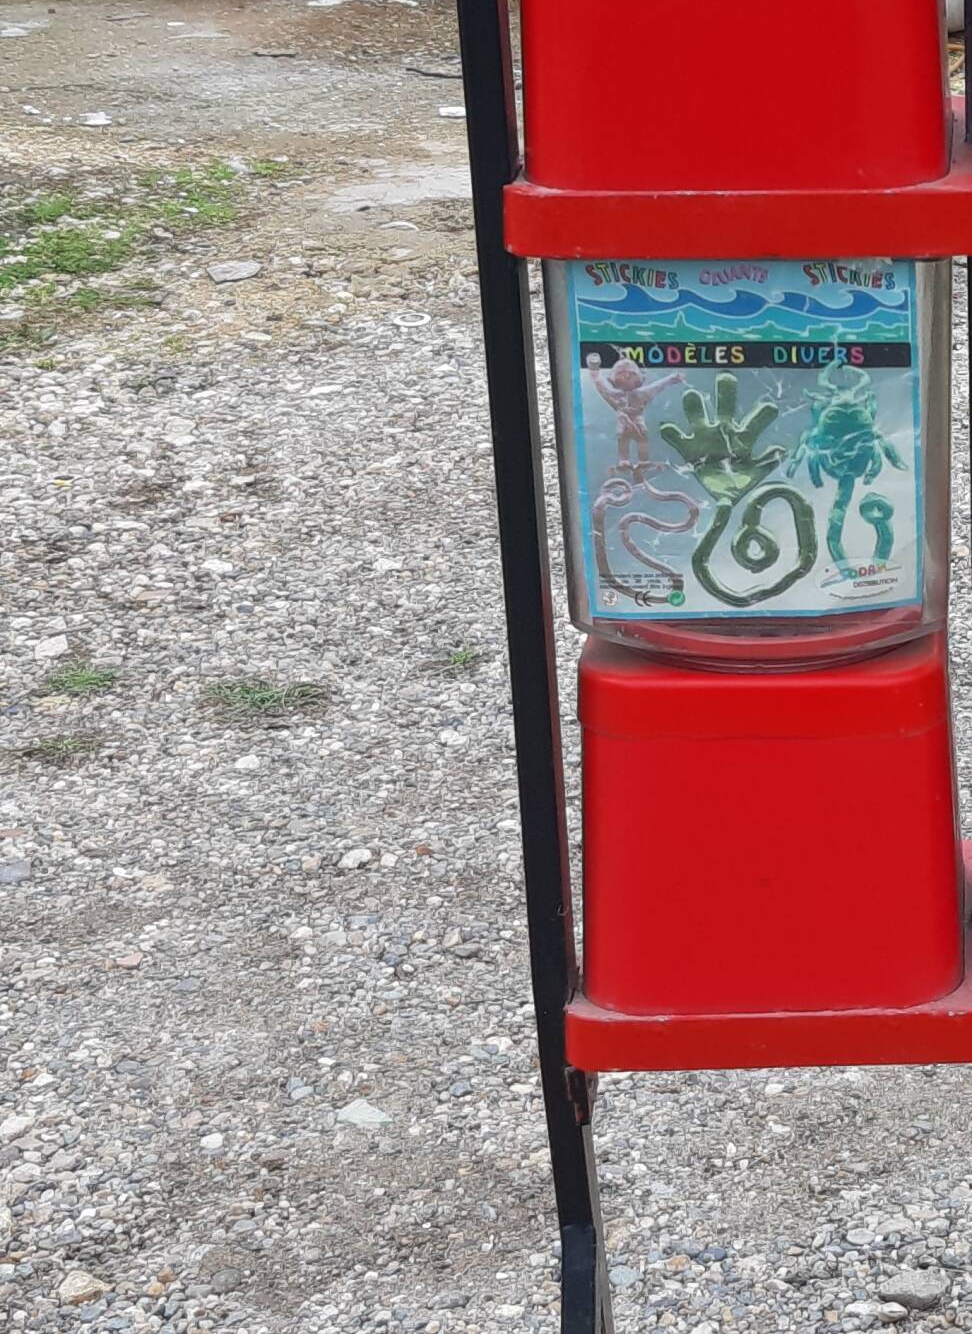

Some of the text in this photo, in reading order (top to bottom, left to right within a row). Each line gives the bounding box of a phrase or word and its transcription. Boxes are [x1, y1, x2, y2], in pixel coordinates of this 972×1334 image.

[585, 262, 680, 290] STICKIES
[803, 262, 896, 290] STICKIES
[626, 343, 865, 365] MODÈLES DIVERS
